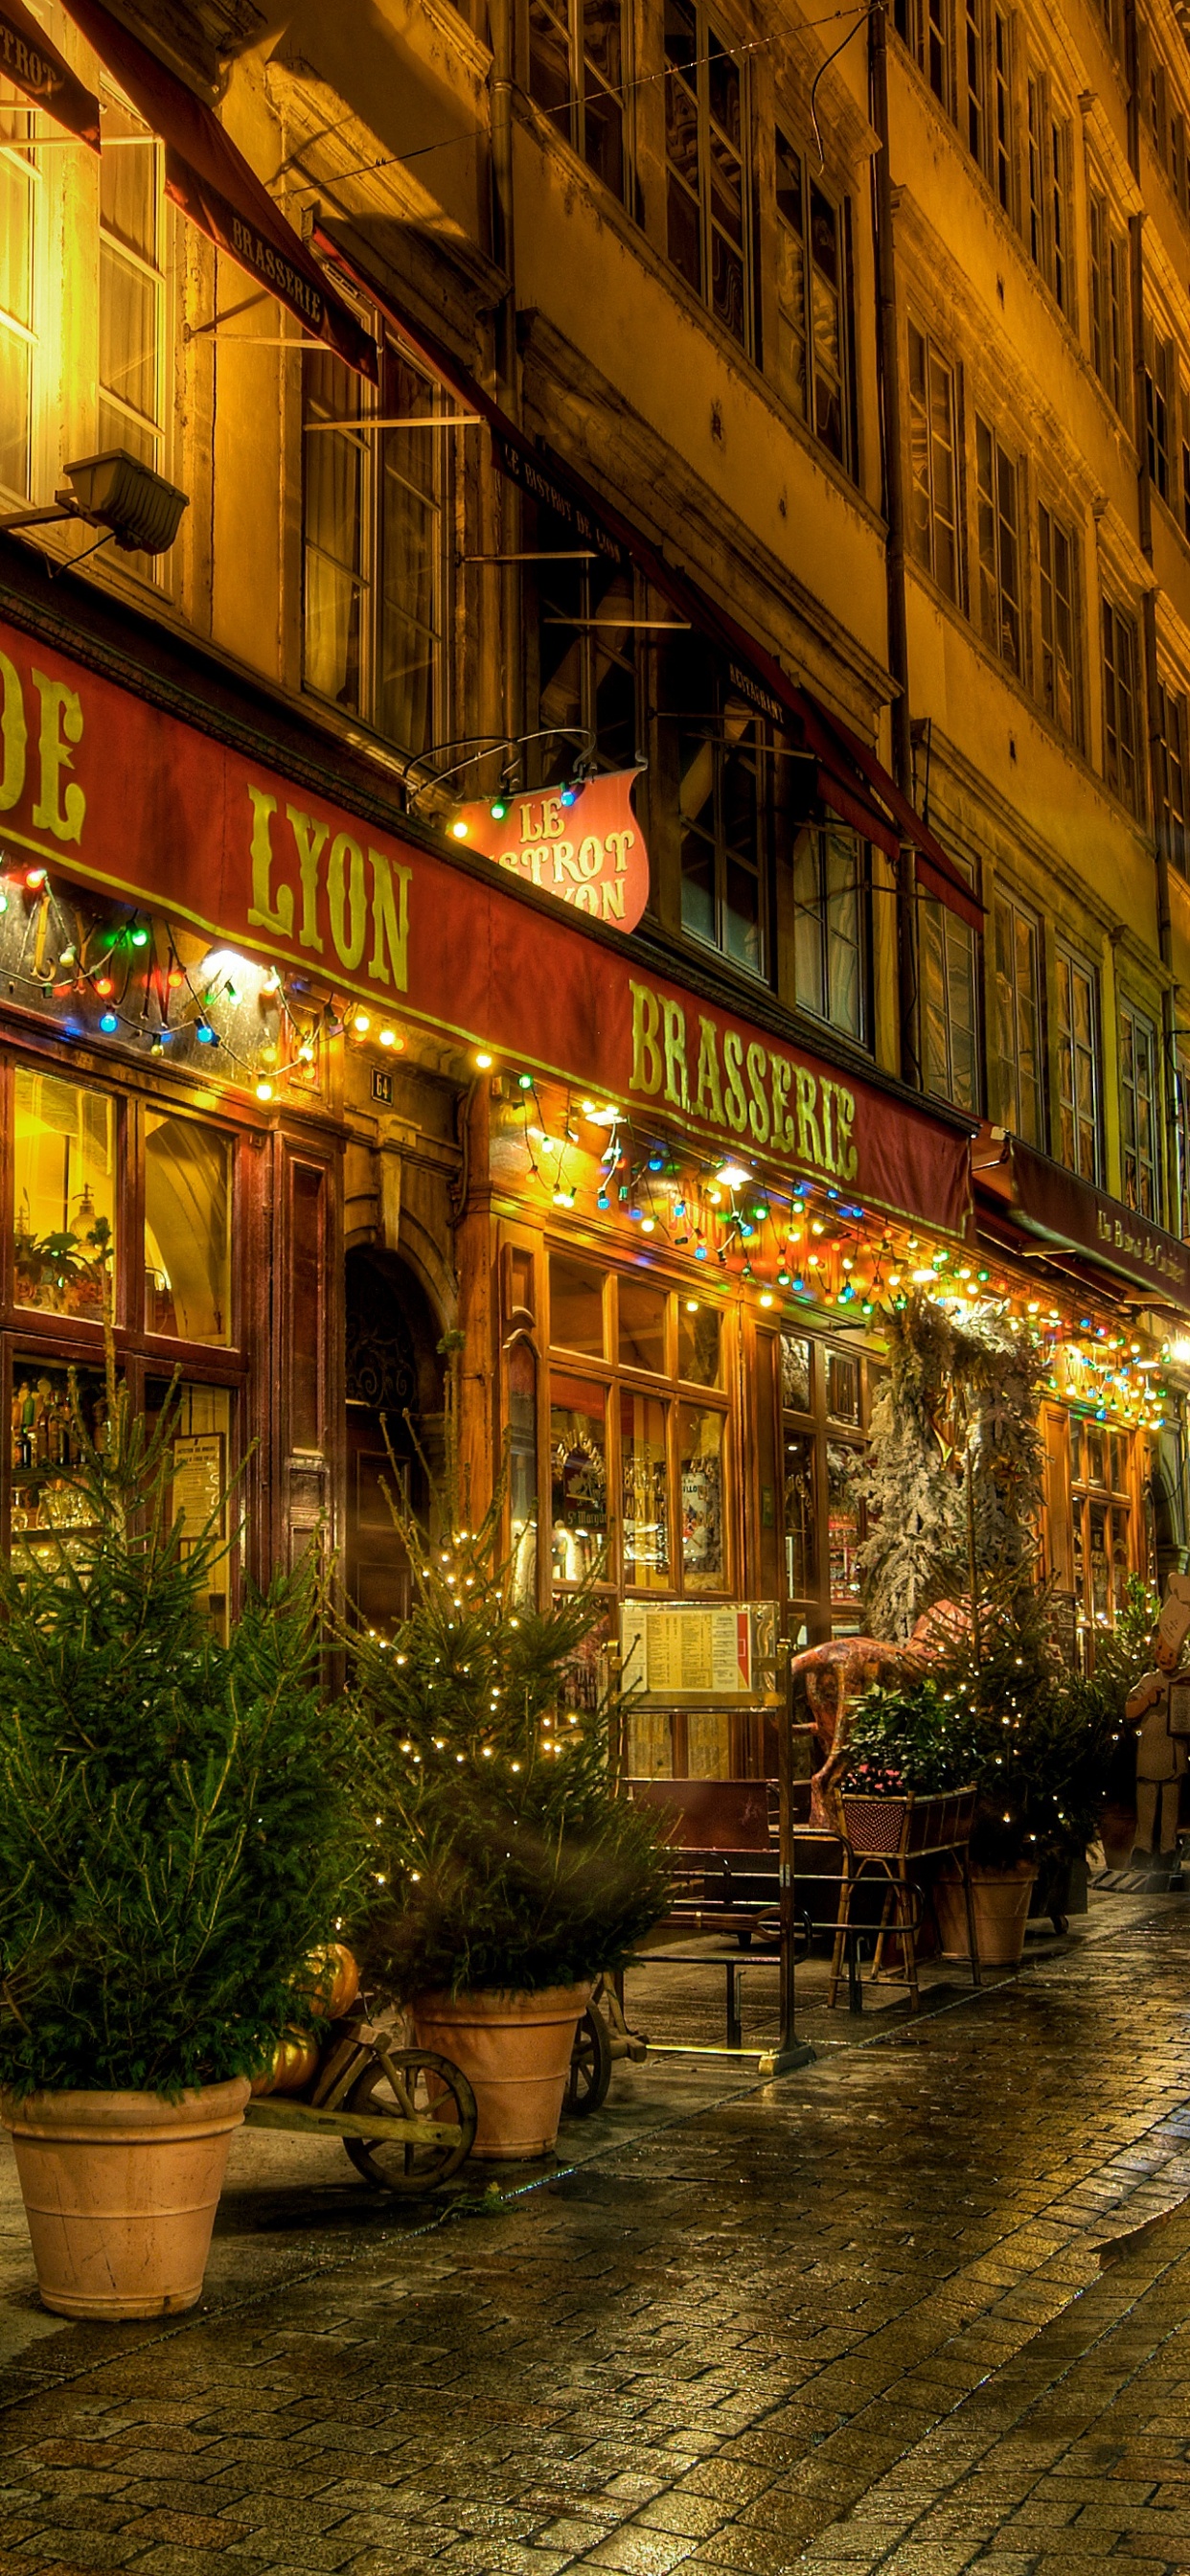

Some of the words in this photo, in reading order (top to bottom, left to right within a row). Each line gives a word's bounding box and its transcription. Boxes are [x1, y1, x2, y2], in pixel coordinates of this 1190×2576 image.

[232, 217, 321, 323] BRASSERIE
[504, 443, 519, 475] LE
[524, 462, 571, 521] BISTROT
[576, 510, 591, 540] DE
[490, 830, 634, 886] STROT
[519, 797, 564, 843] LE
[247, 783, 413, 994] LYON
[377, 1073, 388, 1099] 64
[629, 978, 858, 1182] BRASSERIE
